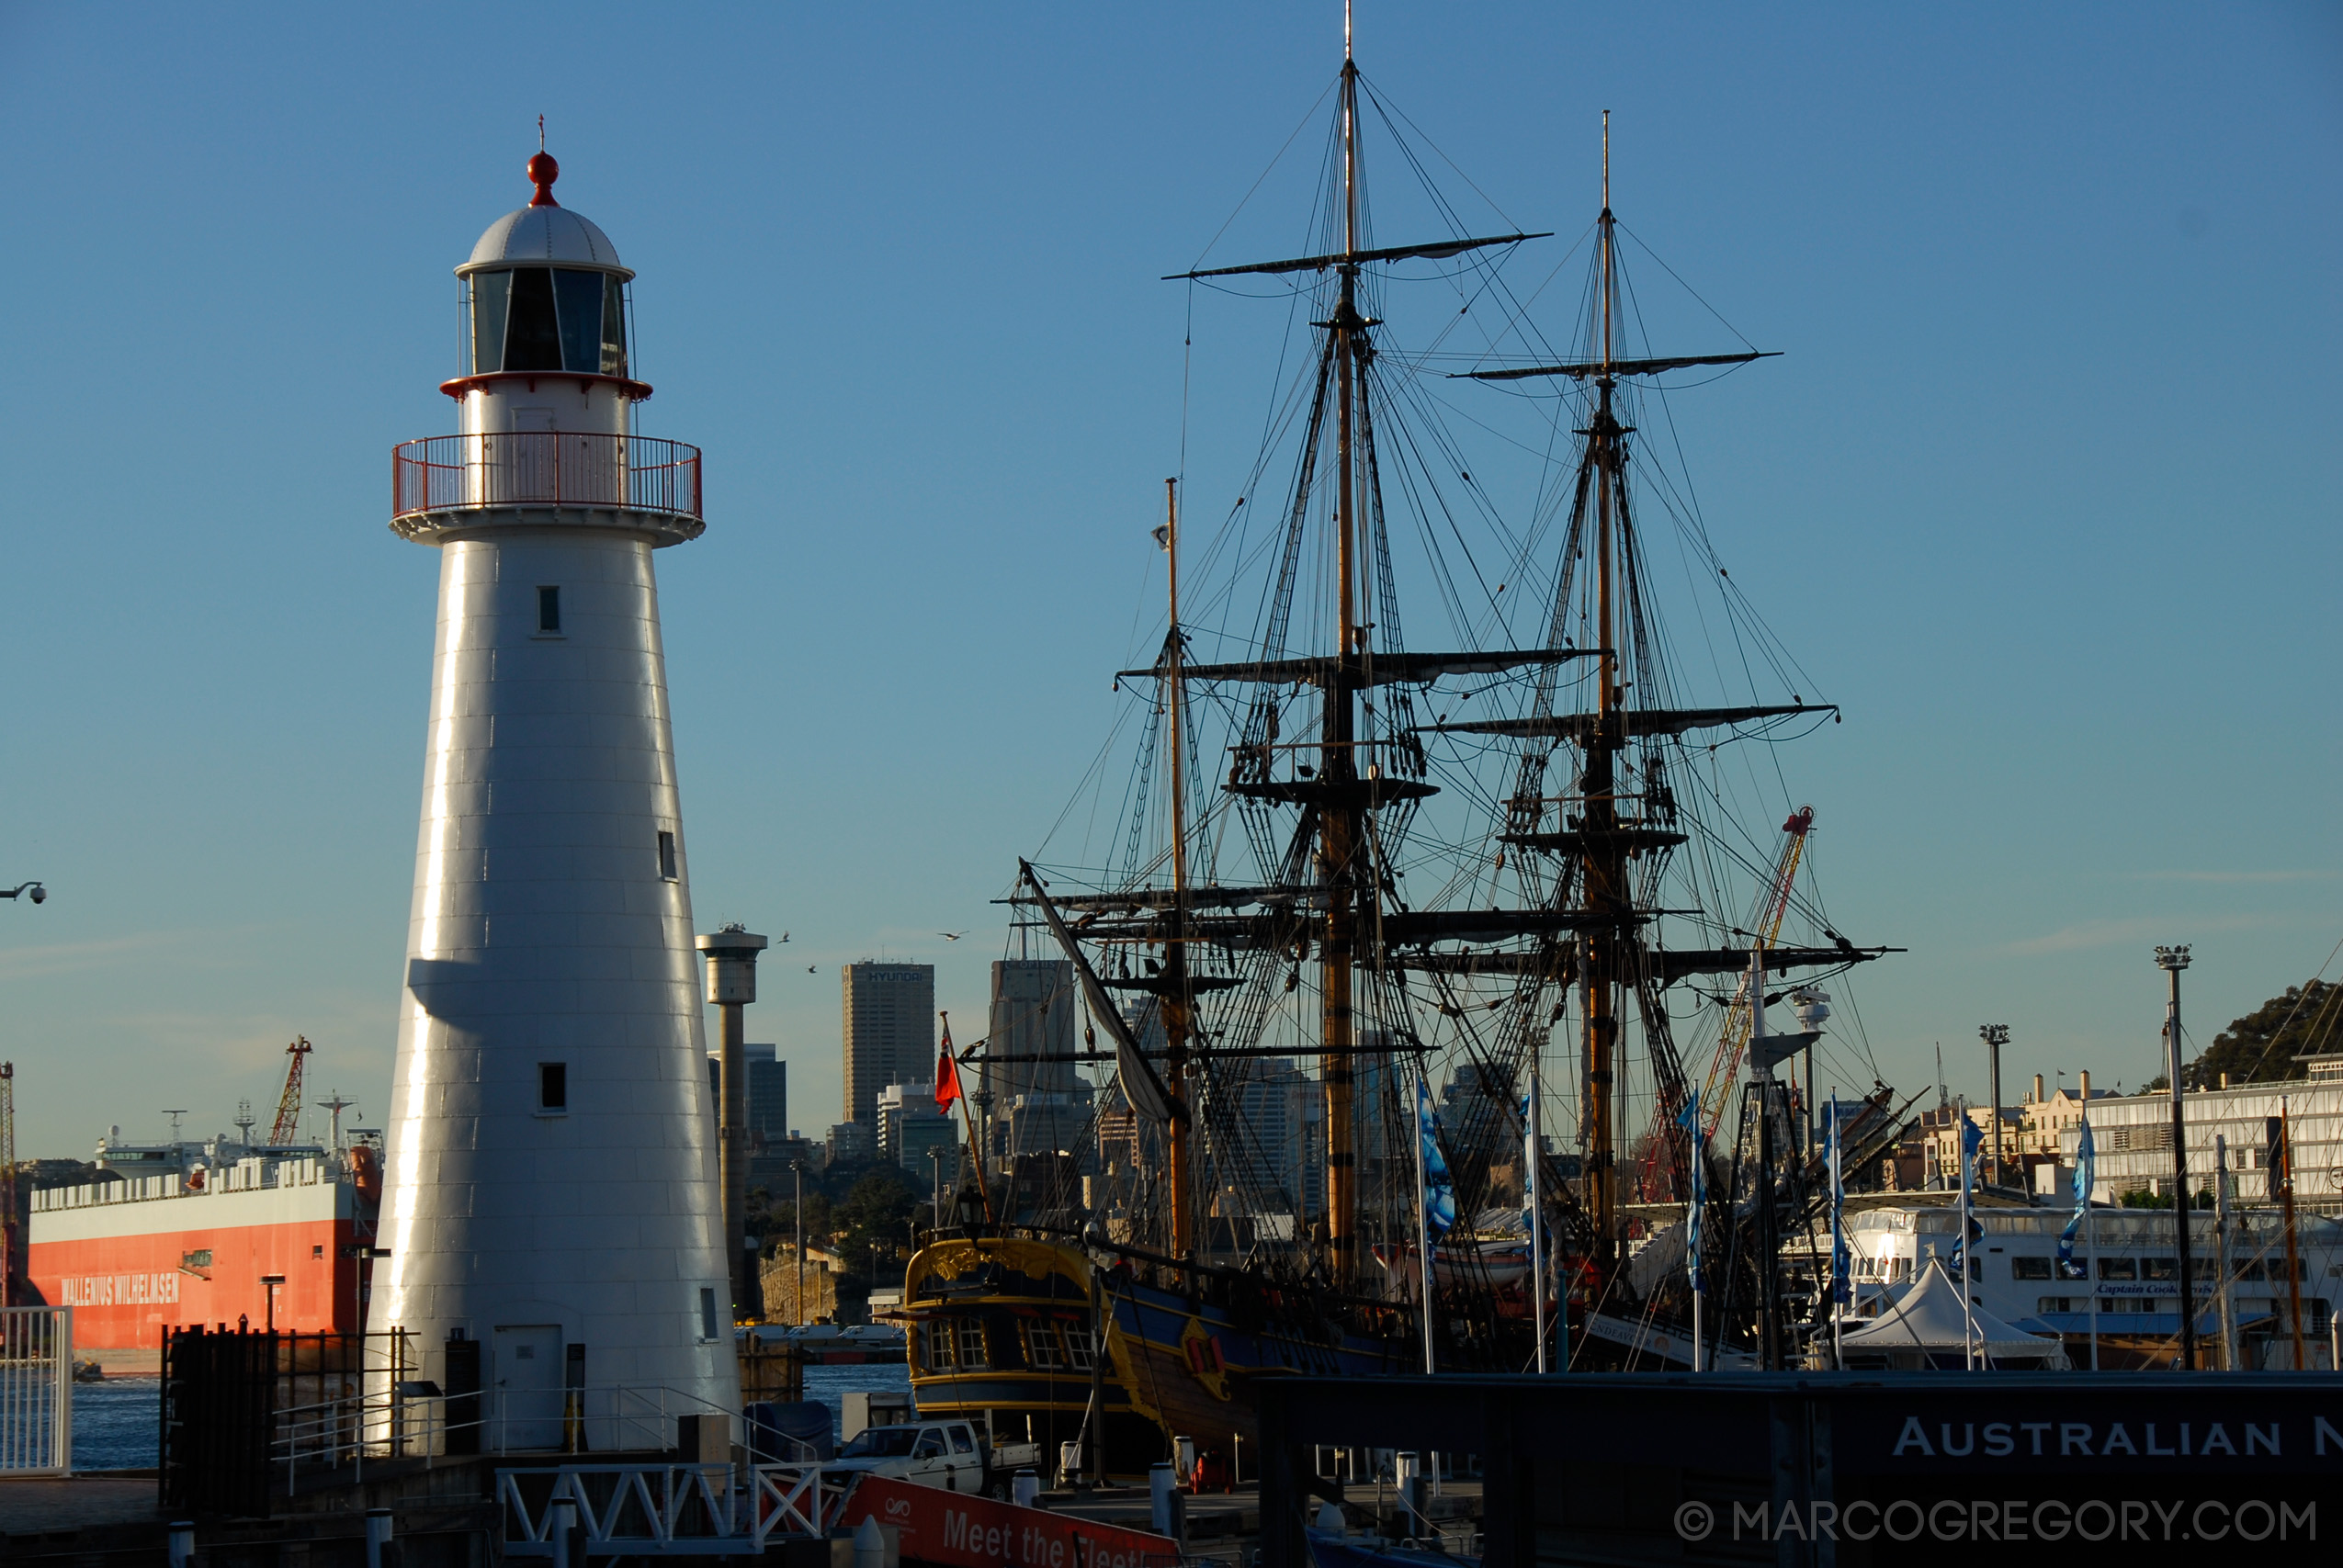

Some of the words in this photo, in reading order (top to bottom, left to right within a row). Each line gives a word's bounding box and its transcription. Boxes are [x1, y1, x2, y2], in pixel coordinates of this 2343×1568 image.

[868, 972, 922, 982] HYUNDAI
[62, 1275, 112, 1306] WALLENIUS
[115, 1272, 179, 1305] WILHELMSEN
[2097, 1284, 2144, 1295] Captain
[2146, 1284, 2177, 1293] Cook
[1590, 1317, 1652, 1348] ENDEAVOUR
[1893, 1416, 2281, 1457] AUSTRALIAN
[943, 1508, 1013, 1559] Meet
[1022, 1523, 1064, 1567] the
